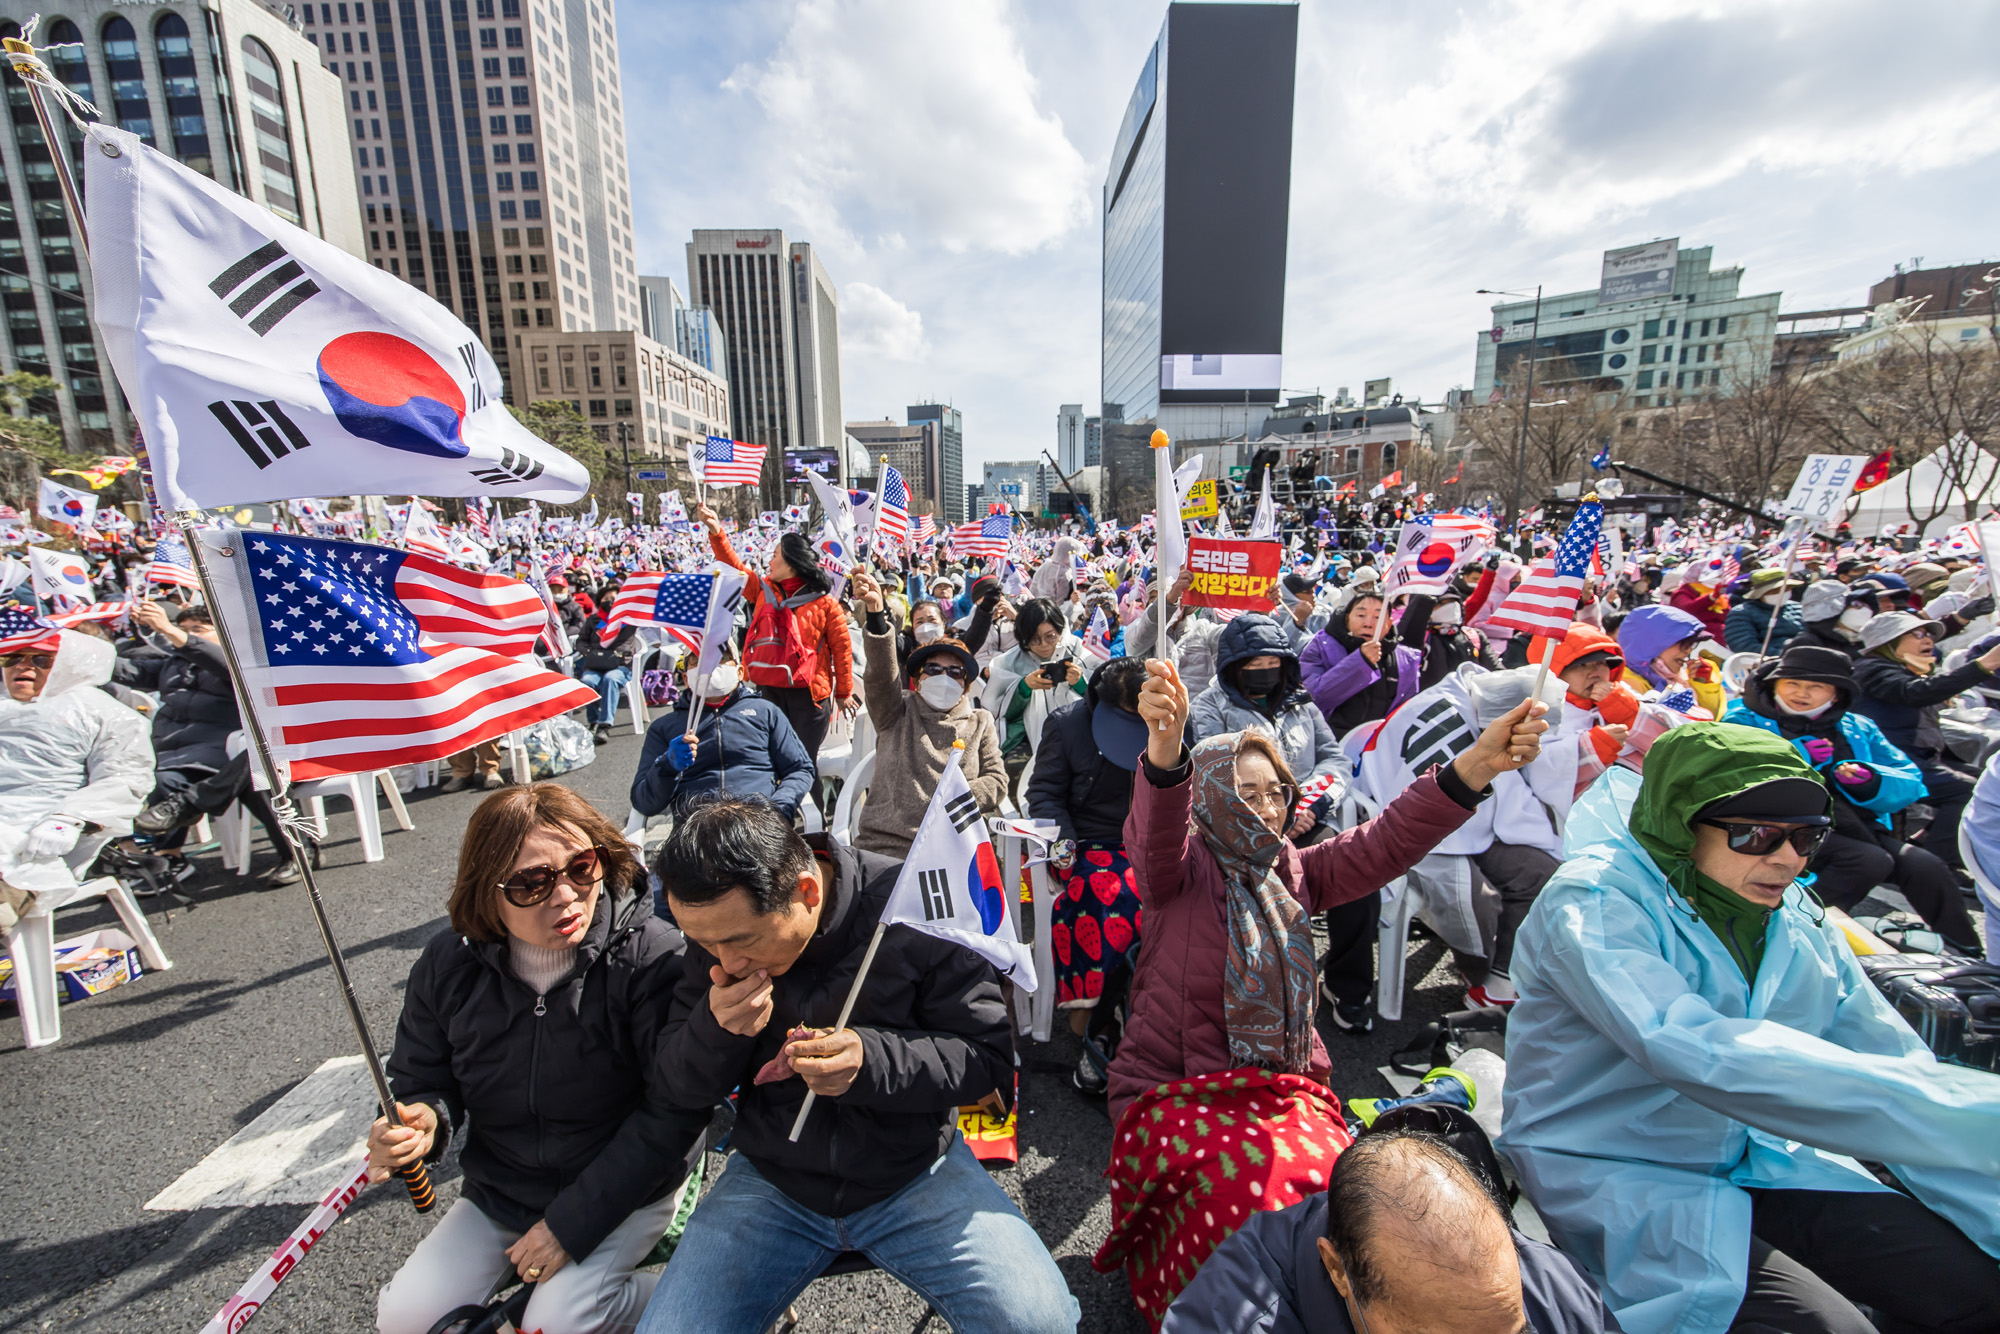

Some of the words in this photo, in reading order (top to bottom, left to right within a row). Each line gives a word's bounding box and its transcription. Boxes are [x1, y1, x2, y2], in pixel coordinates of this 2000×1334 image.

[736, 239, 766, 248] kobaco
[1605, 283, 1637, 296] TOEFL
[1808, 458, 1852, 487] 정읍
[1187, 482, 1212, 497] 의성
[1790, 487, 1840, 516] 고창
[1191, 549, 1249, 574] 국민은
[1188, 572, 1277, 598] 저항한다!
